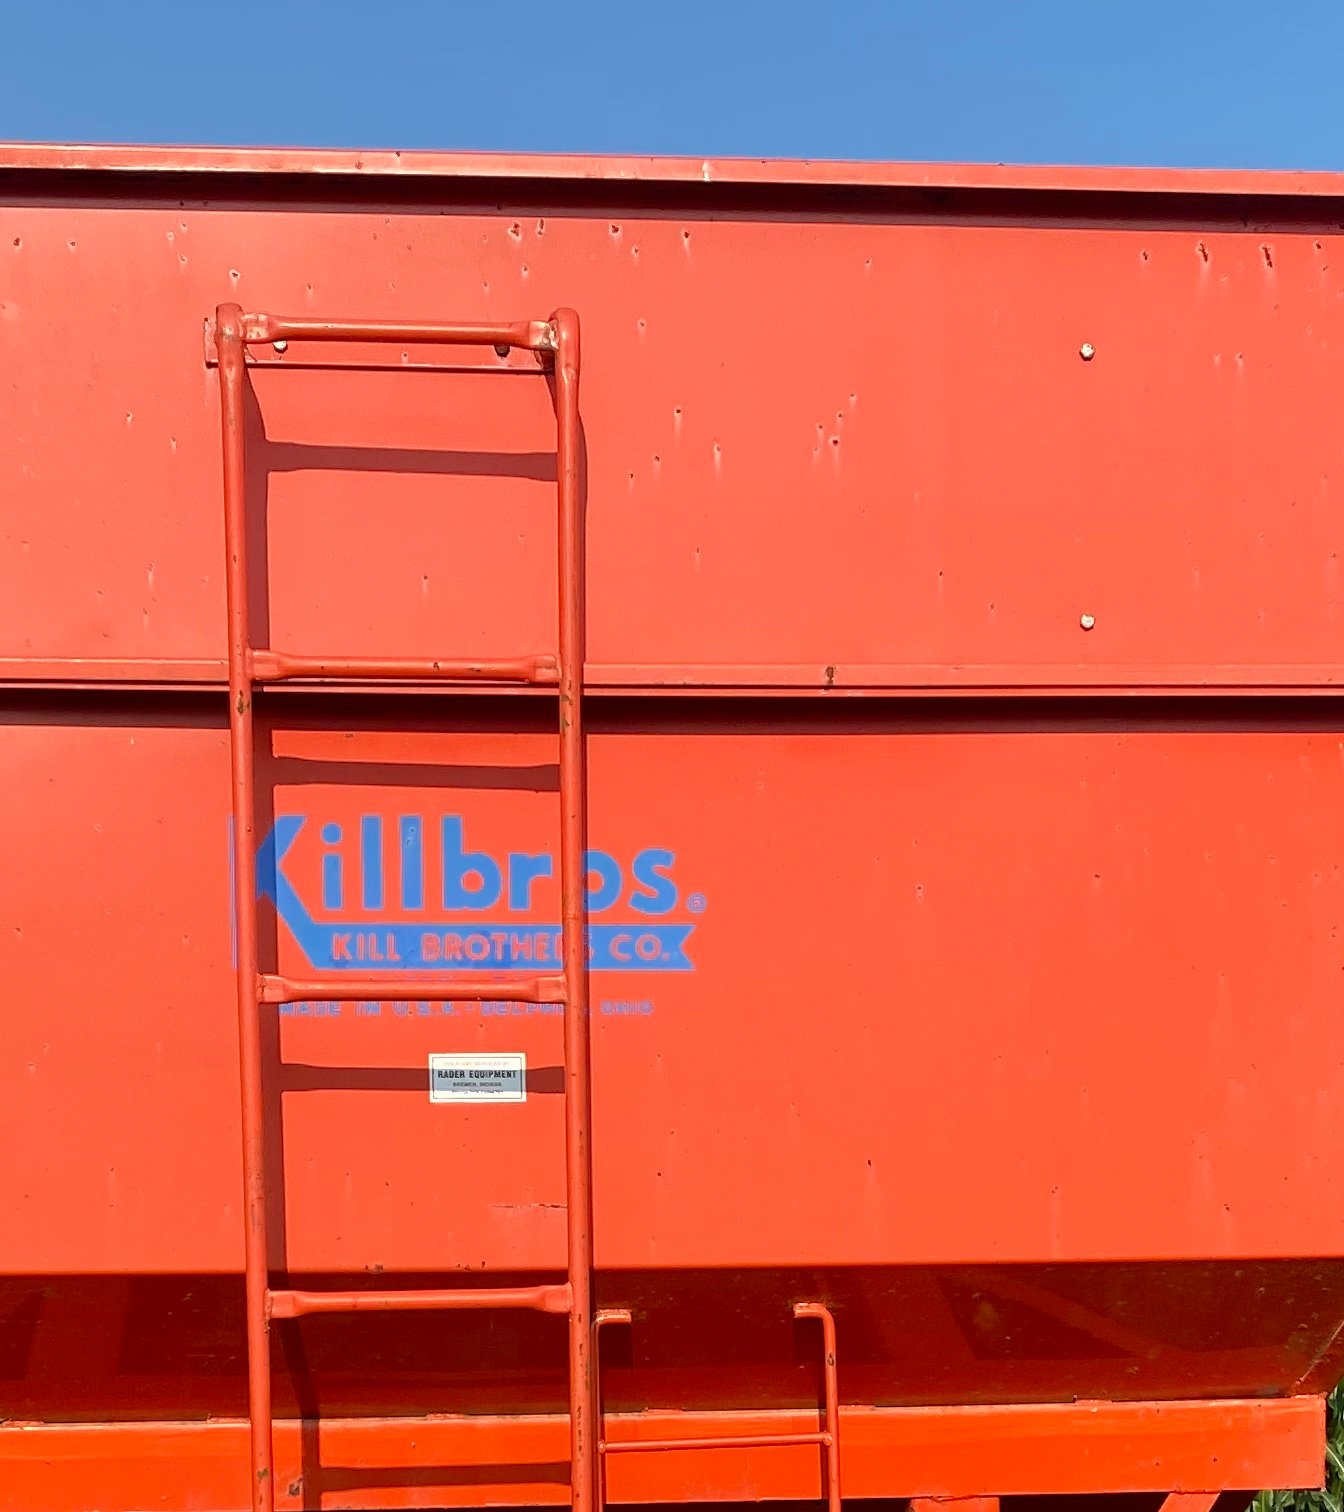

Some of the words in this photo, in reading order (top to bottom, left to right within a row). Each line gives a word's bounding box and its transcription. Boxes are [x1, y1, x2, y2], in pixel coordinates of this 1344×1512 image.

[332, 933, 400, 962] KILL
[421, 933, 595, 962] BROTHES
[609, 933, 671, 961] CO.
[437, 1070, 465, 1079] RADER
[469, 1069, 517, 1079] EQUIPMENT
